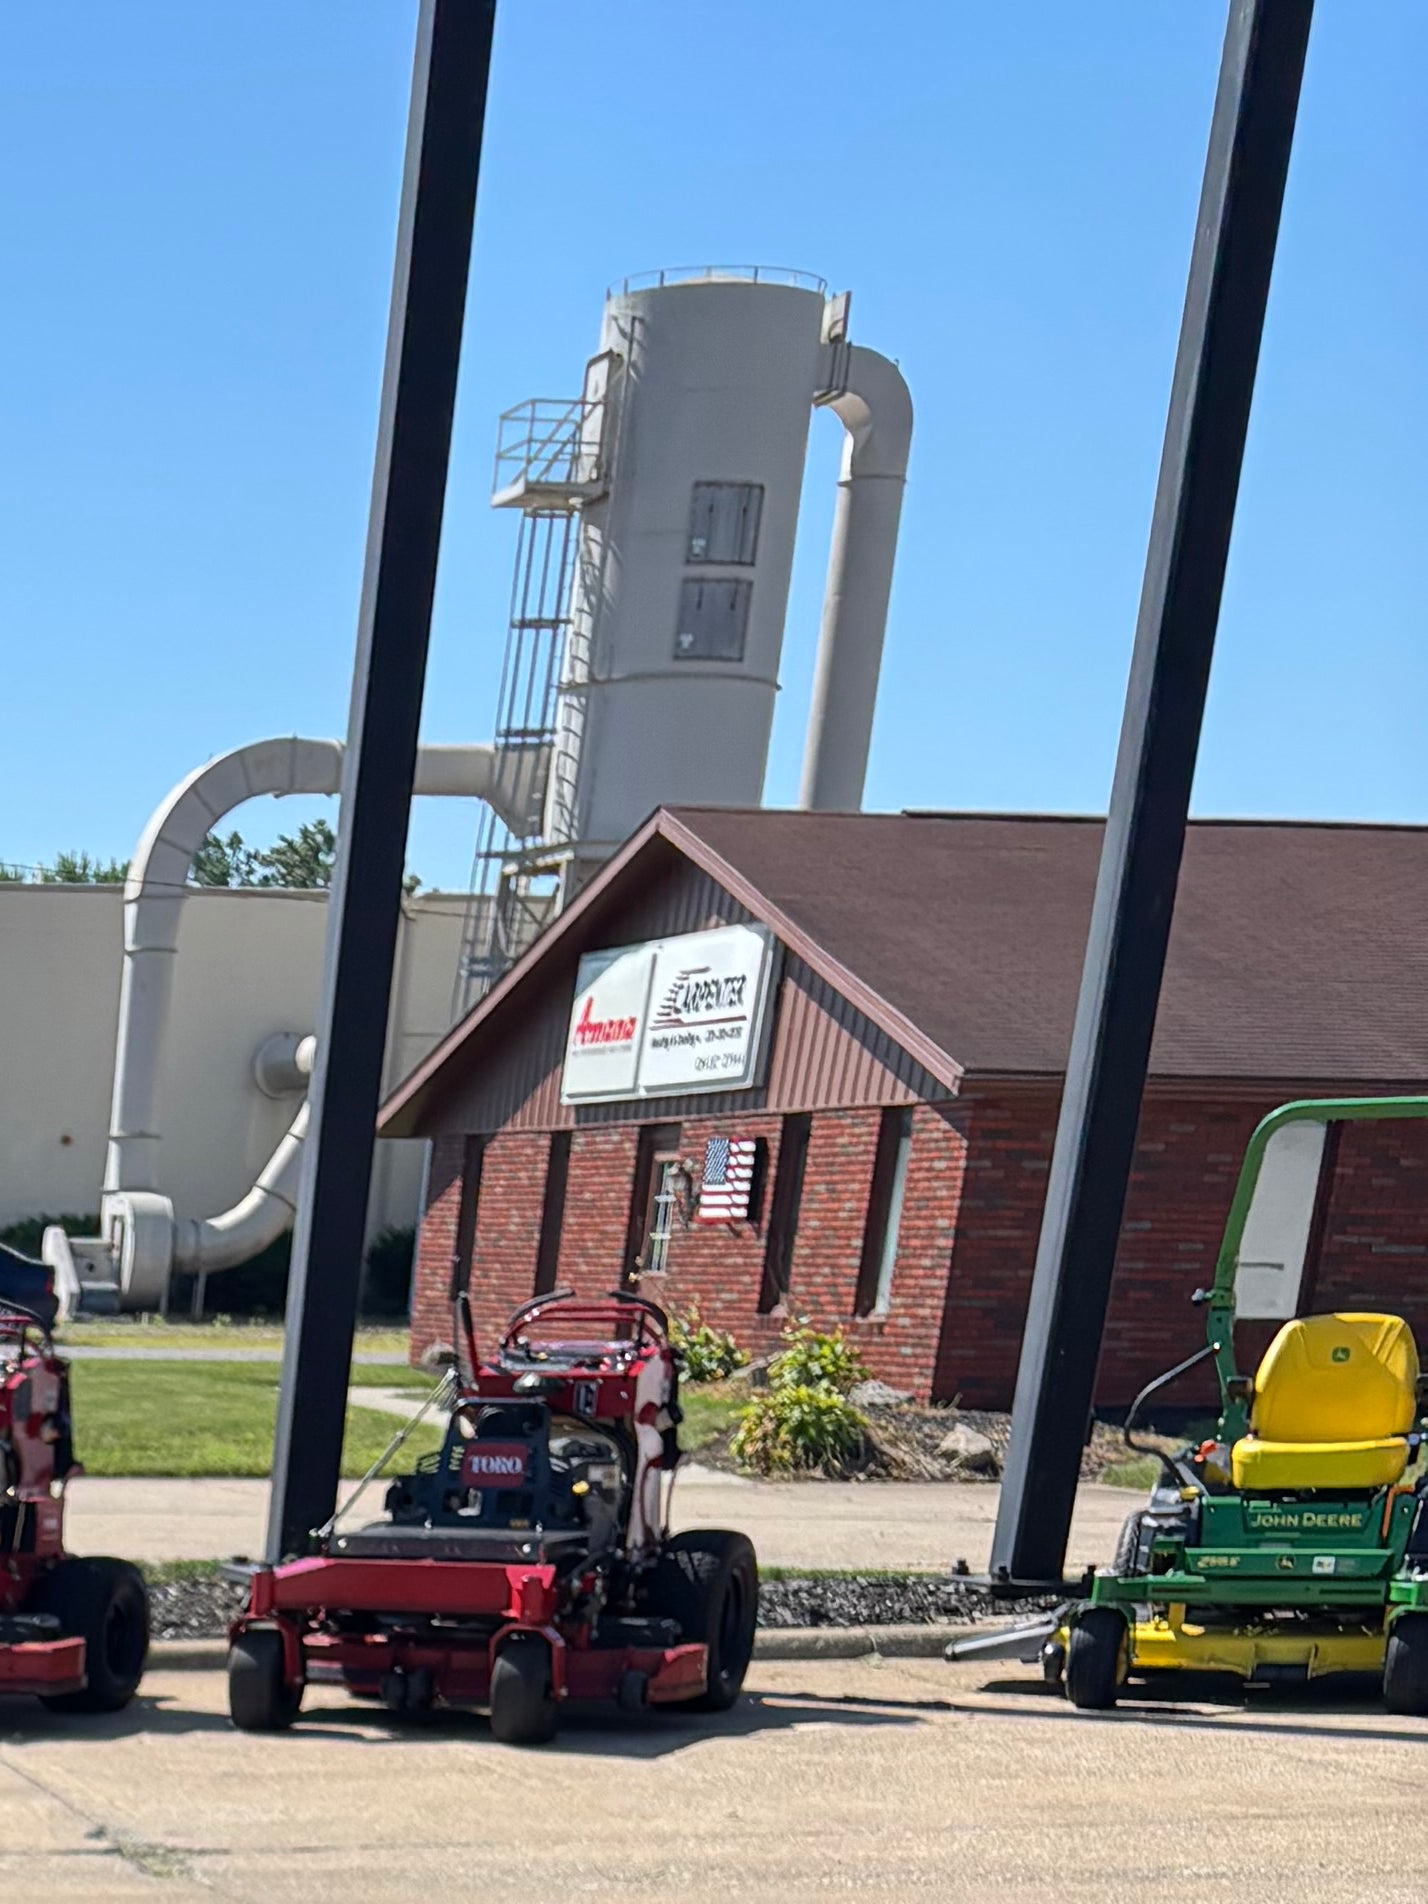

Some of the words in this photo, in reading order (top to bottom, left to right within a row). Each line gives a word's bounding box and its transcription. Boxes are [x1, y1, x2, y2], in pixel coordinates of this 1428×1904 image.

[469, 1454, 523, 1475] TORO
[1251, 1512, 1299, 1528] JOHN
[1302, 1512, 1362, 1528] DEERE
